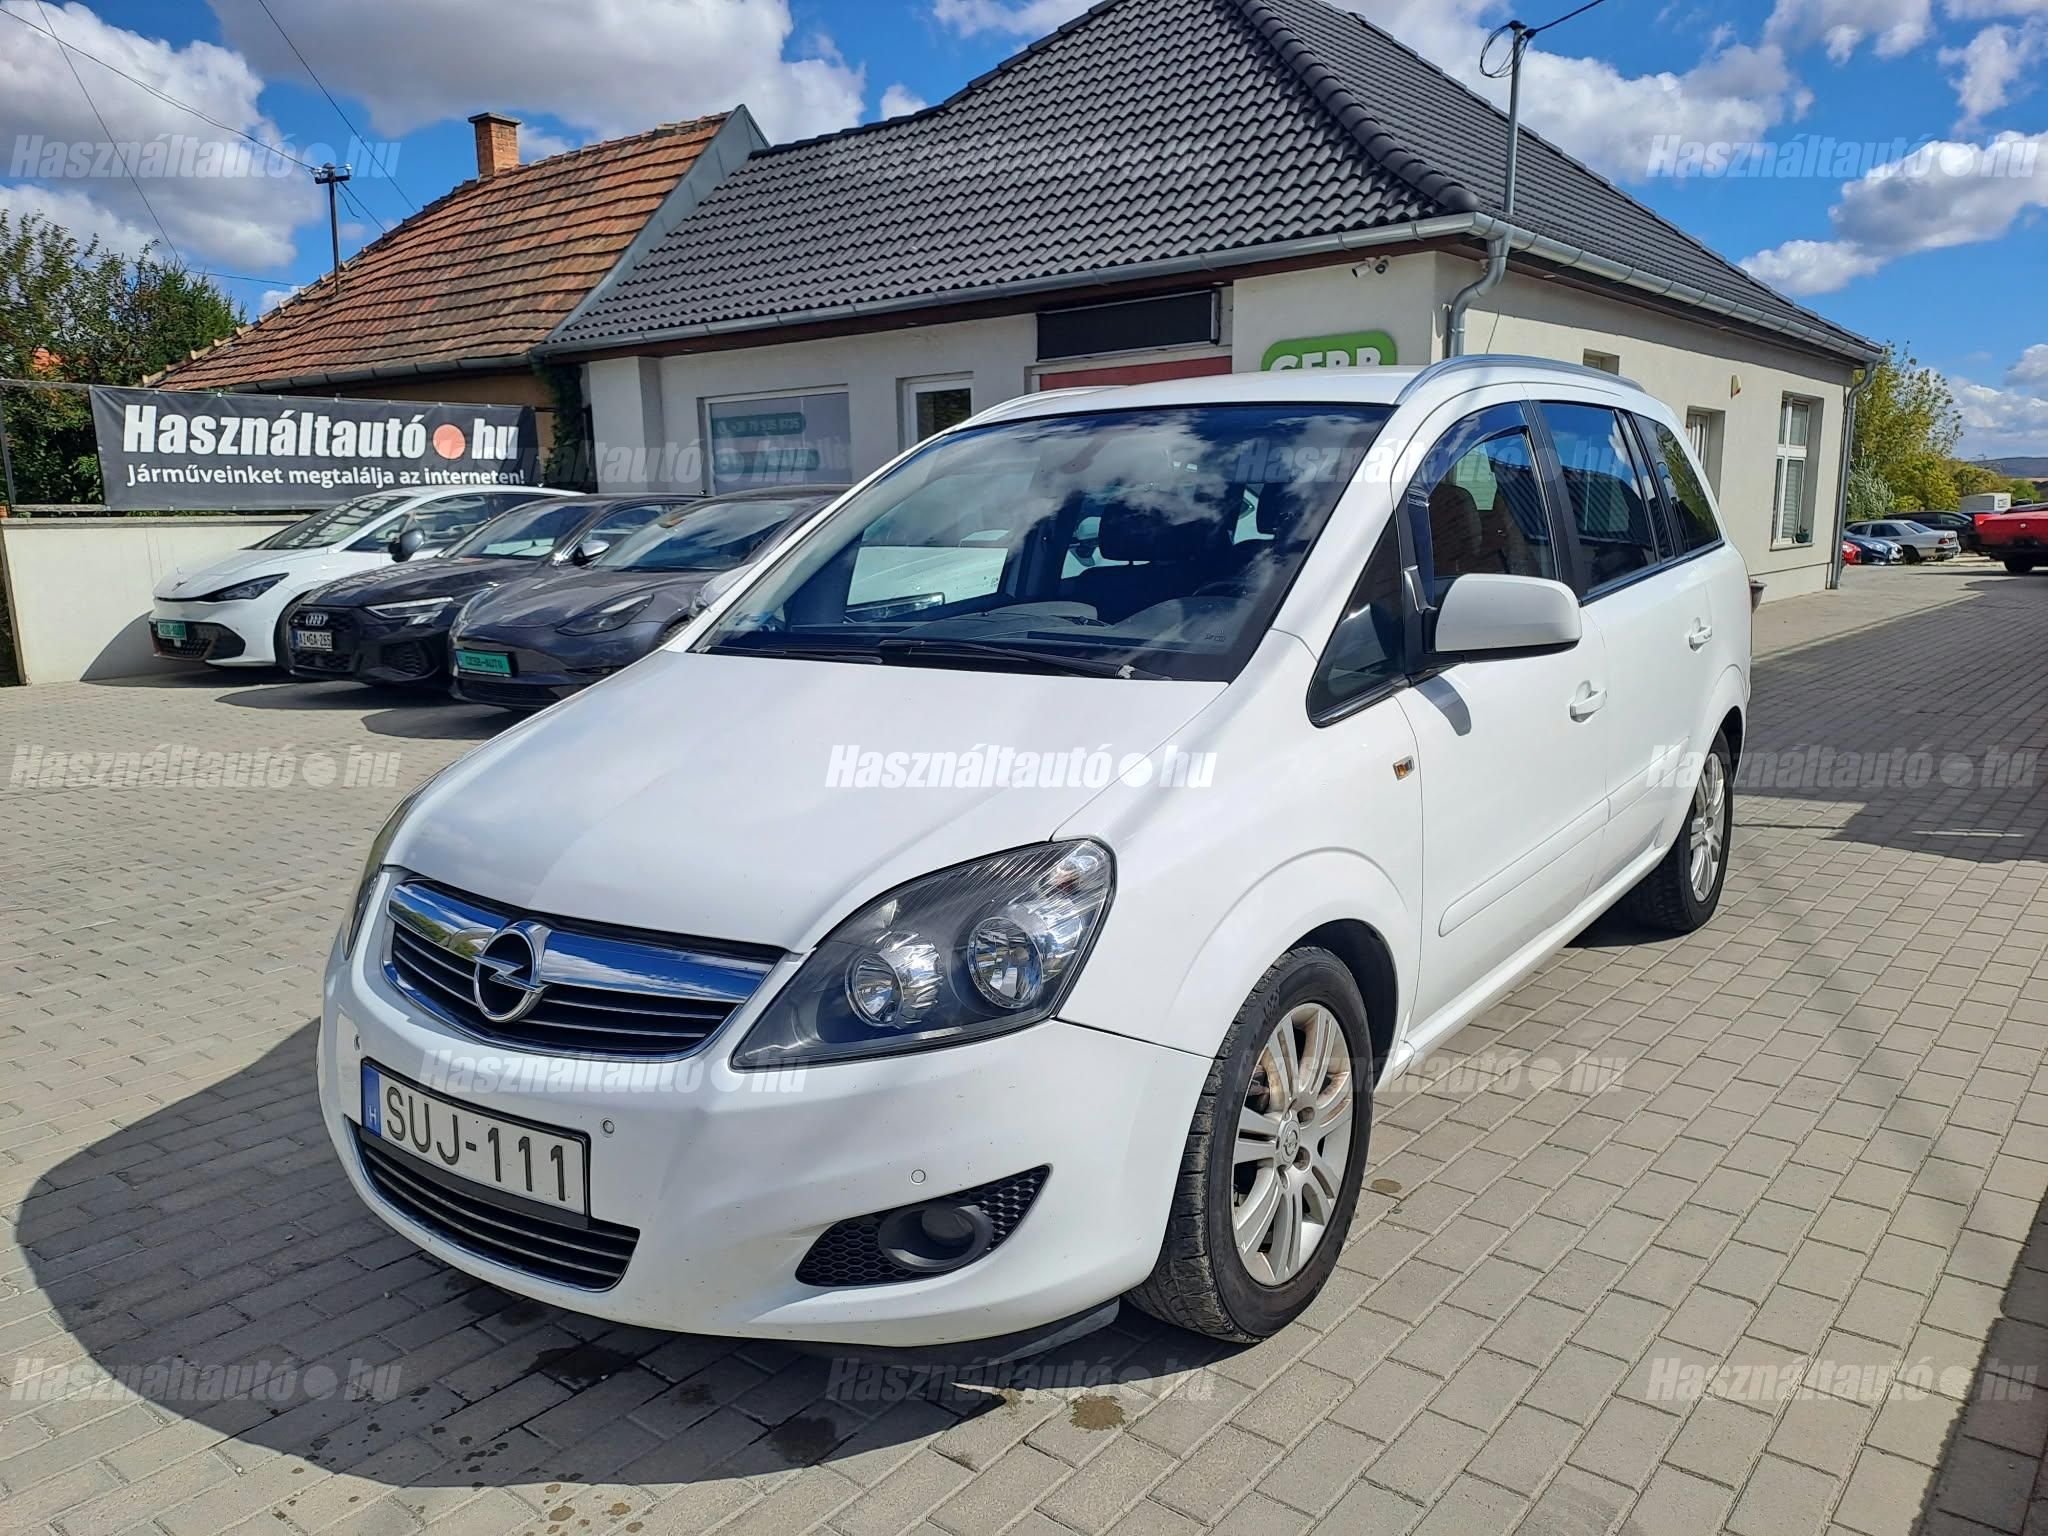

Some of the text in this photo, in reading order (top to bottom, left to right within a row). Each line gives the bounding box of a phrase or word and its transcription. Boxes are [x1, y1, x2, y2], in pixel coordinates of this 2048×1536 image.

[123, 404, 519, 460] Használtautó hu
[127, 464, 526, 488] Járműveinket megtalálja az interneten!
[386, 1085, 567, 1202] SUJ-111
